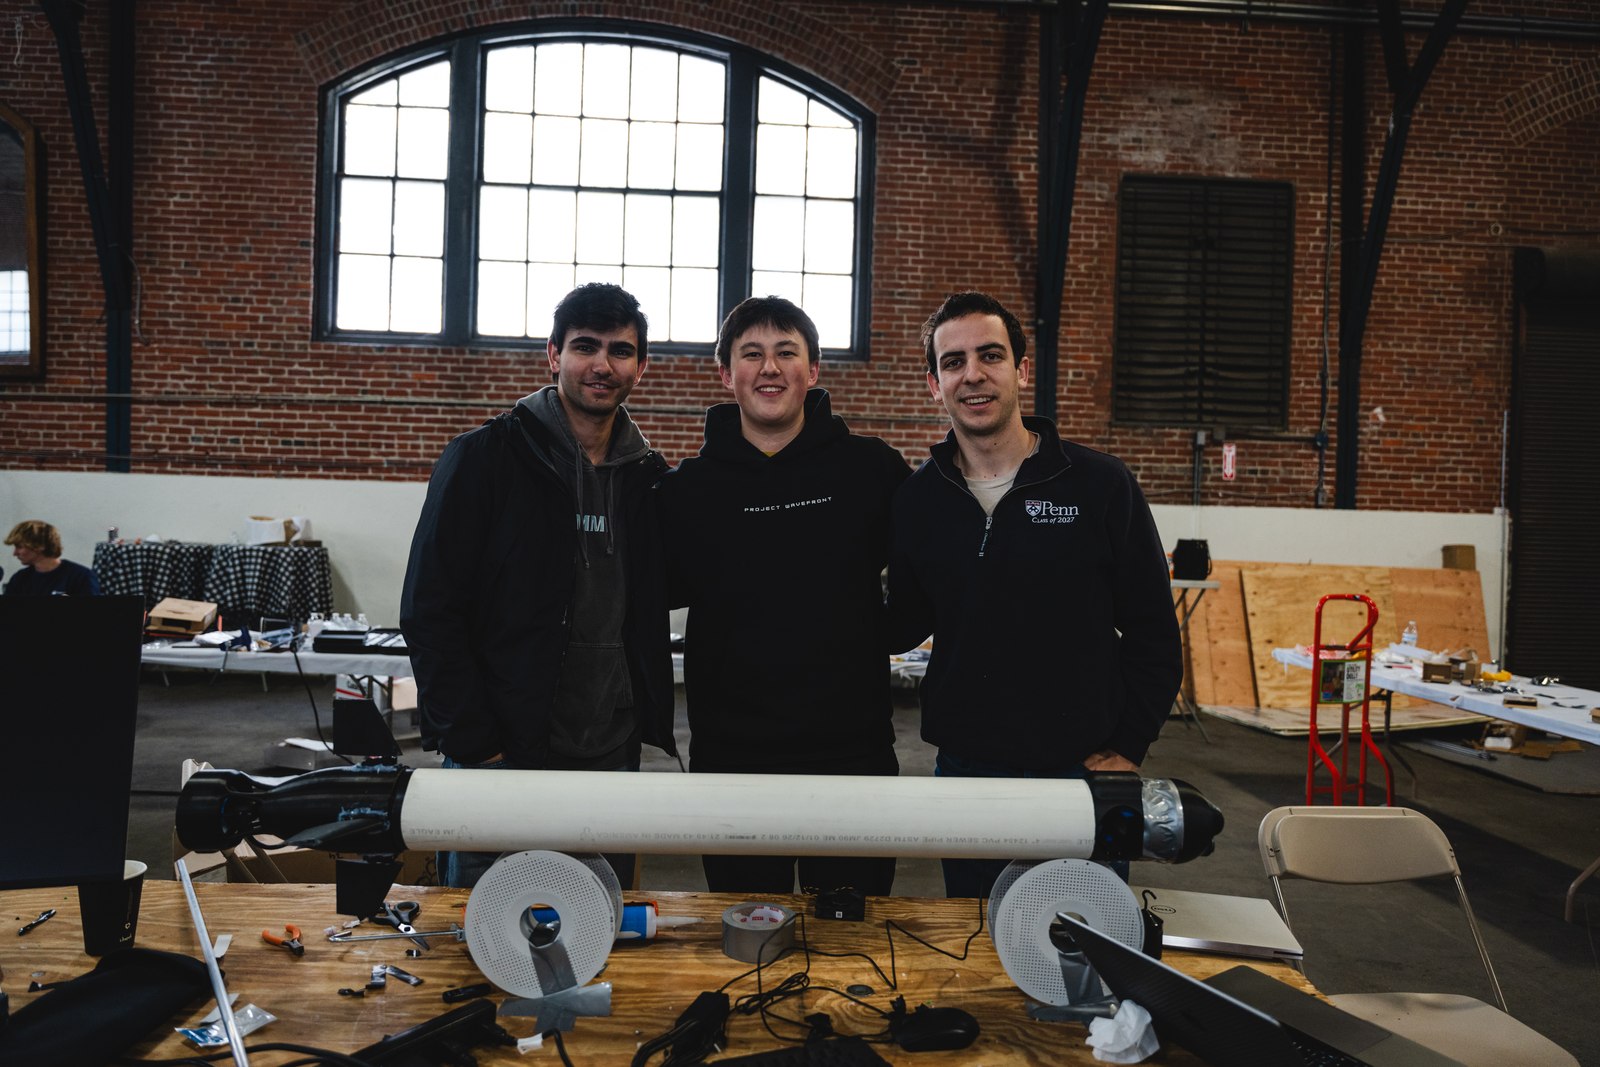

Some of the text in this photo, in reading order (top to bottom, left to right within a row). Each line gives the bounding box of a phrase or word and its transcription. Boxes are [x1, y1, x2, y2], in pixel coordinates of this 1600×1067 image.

[785, 496, 832, 509] WAVEFRONT
[1041, 501, 1079, 516] Penn
[576, 513, 608, 533] MM
[1058, 516, 1075, 524] 2027
